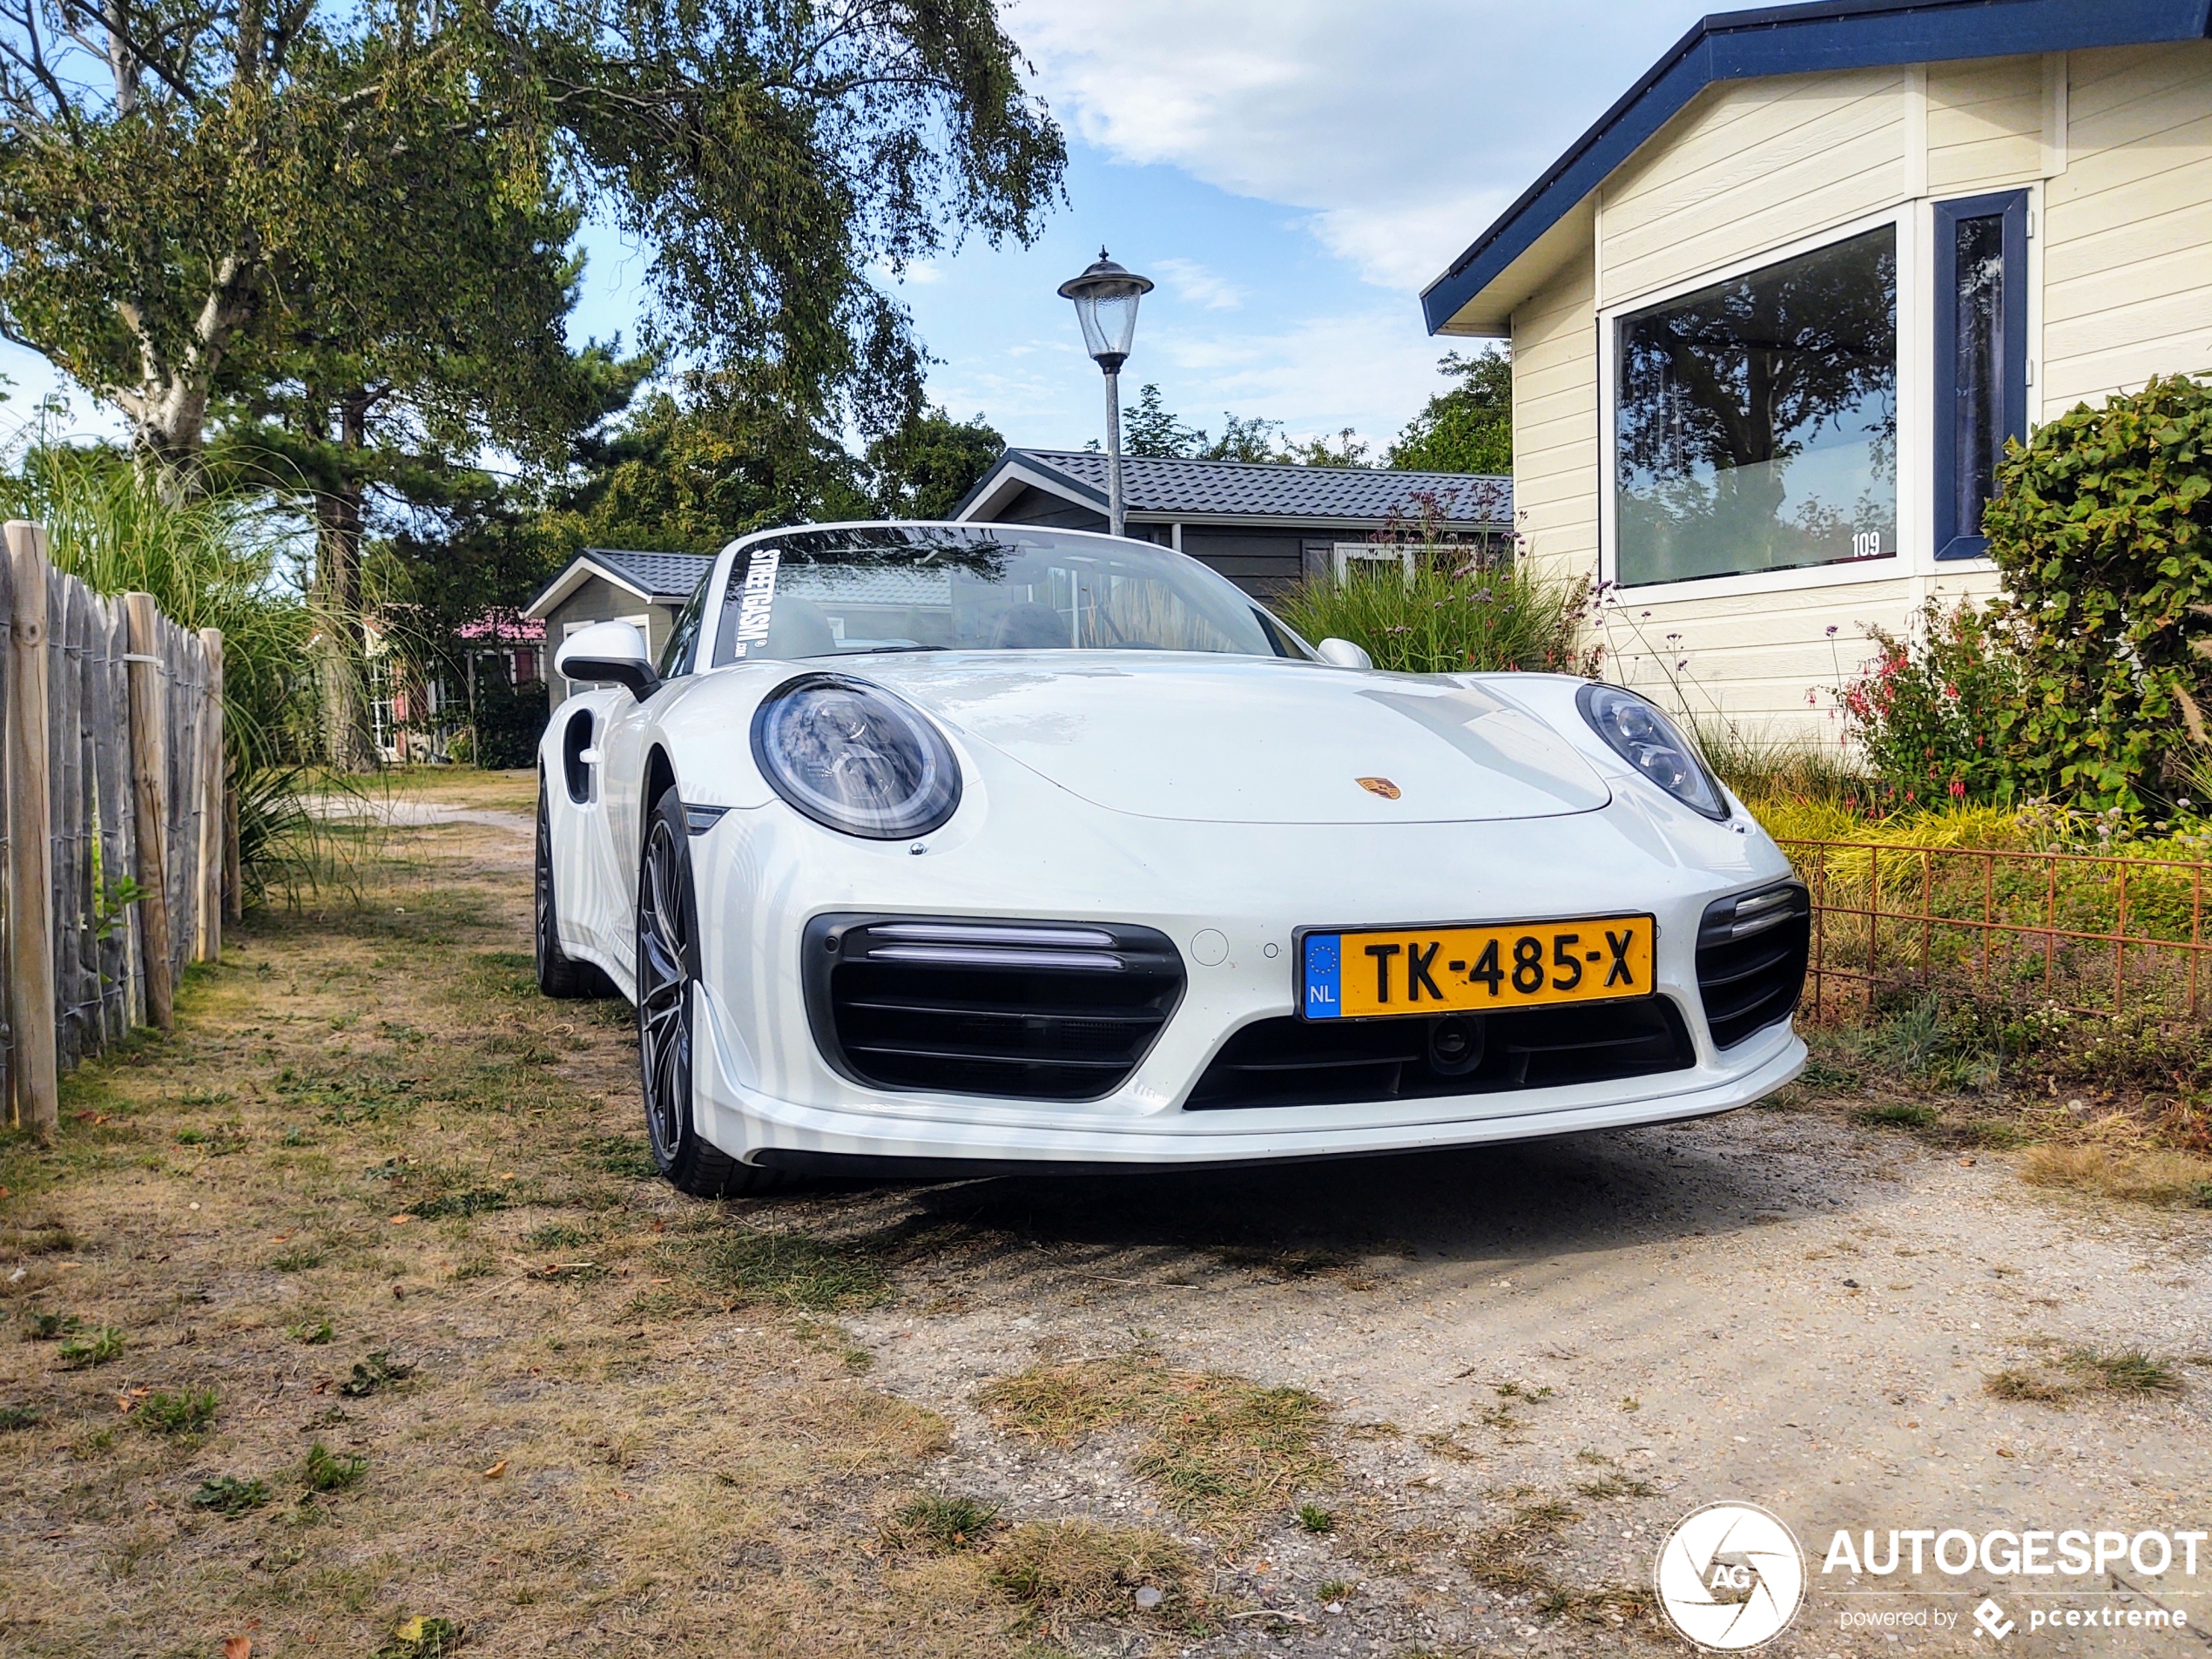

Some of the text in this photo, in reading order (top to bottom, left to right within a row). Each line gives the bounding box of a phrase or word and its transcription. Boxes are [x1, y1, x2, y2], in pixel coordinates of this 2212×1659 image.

[1851, 531, 1880, 557] 109
[1365, 929, 1634, 1002] TK-485-X
[1310, 985, 1336, 1004] NL
